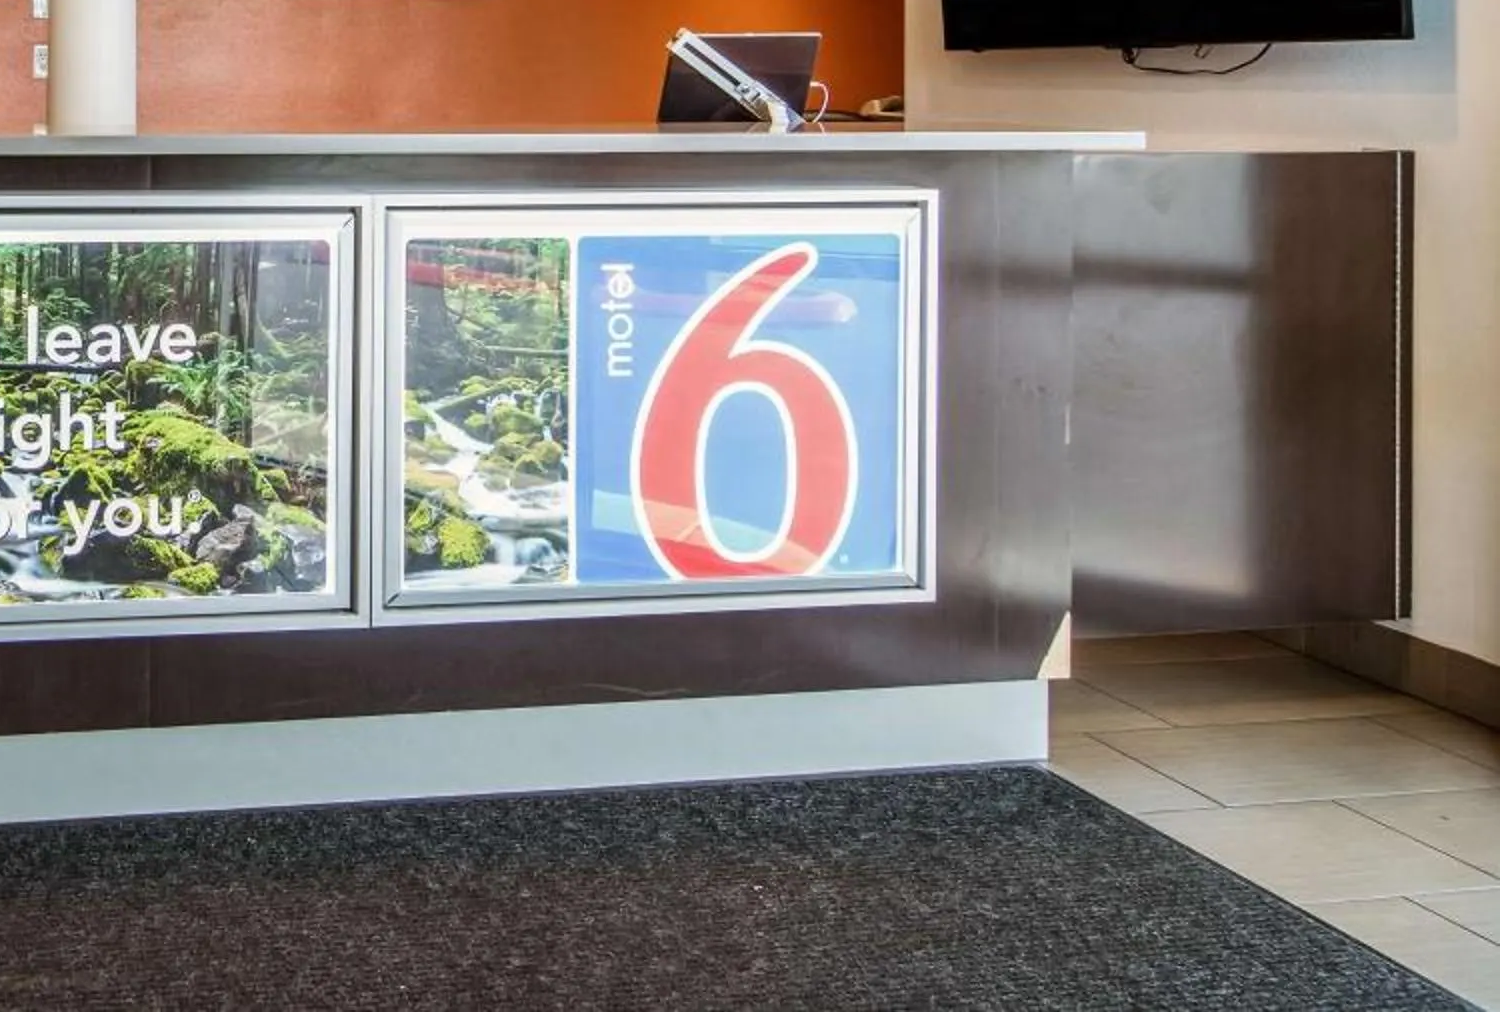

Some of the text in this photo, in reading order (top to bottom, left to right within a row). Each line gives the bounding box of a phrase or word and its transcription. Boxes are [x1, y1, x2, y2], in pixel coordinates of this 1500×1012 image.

[26, 306, 198, 364] leave
[601, 263, 635, 377] motel
[630, 241, 859, 580] 6
